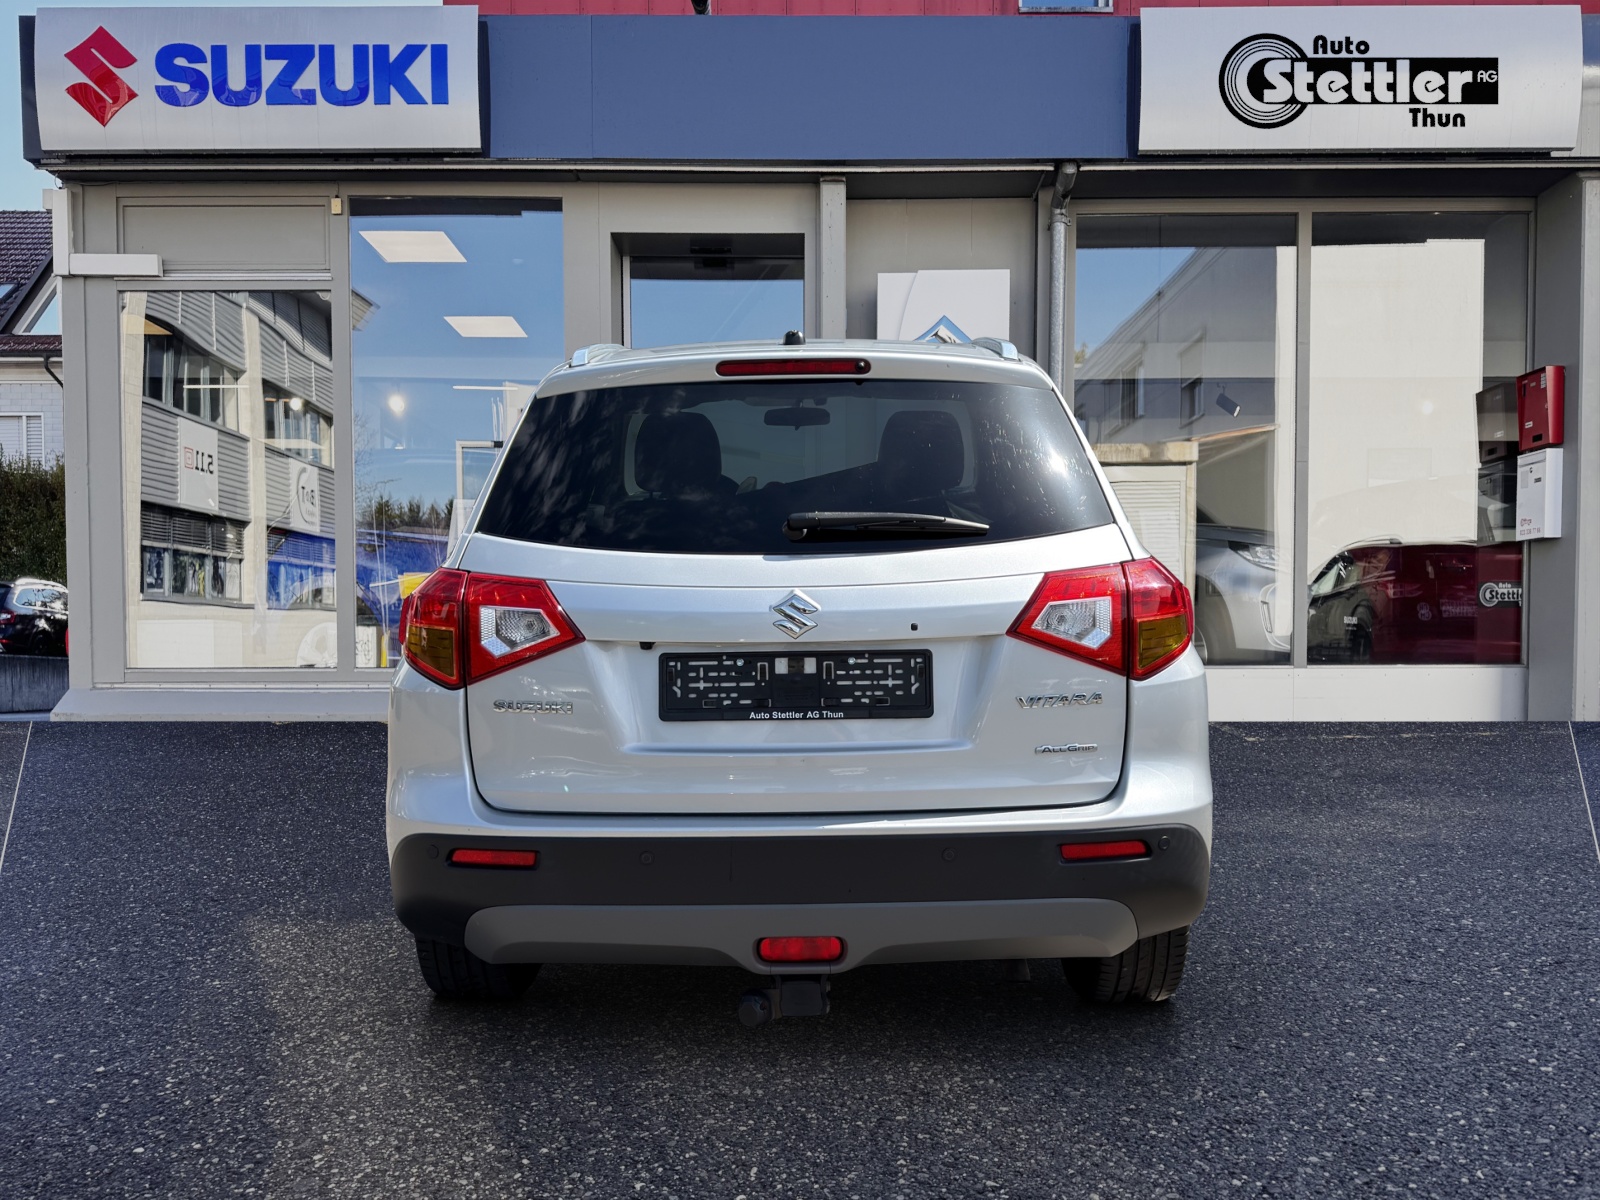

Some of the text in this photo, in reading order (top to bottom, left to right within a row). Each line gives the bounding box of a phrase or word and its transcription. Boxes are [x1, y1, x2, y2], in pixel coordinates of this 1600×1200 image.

[1312, 34, 1370, 55] Auto
[154, 42, 449, 107] SUZUKI
[1263, 59, 1498, 103] Stettler AG
[1408, 107, 1466, 128] Thun
[1488, 589, 1522, 600] Stettl
[493, 699, 573, 714] SUZUKI
[1015, 692, 1104, 709] VITARA
[749, 710, 844, 719] Auto Stettler AG Thun
